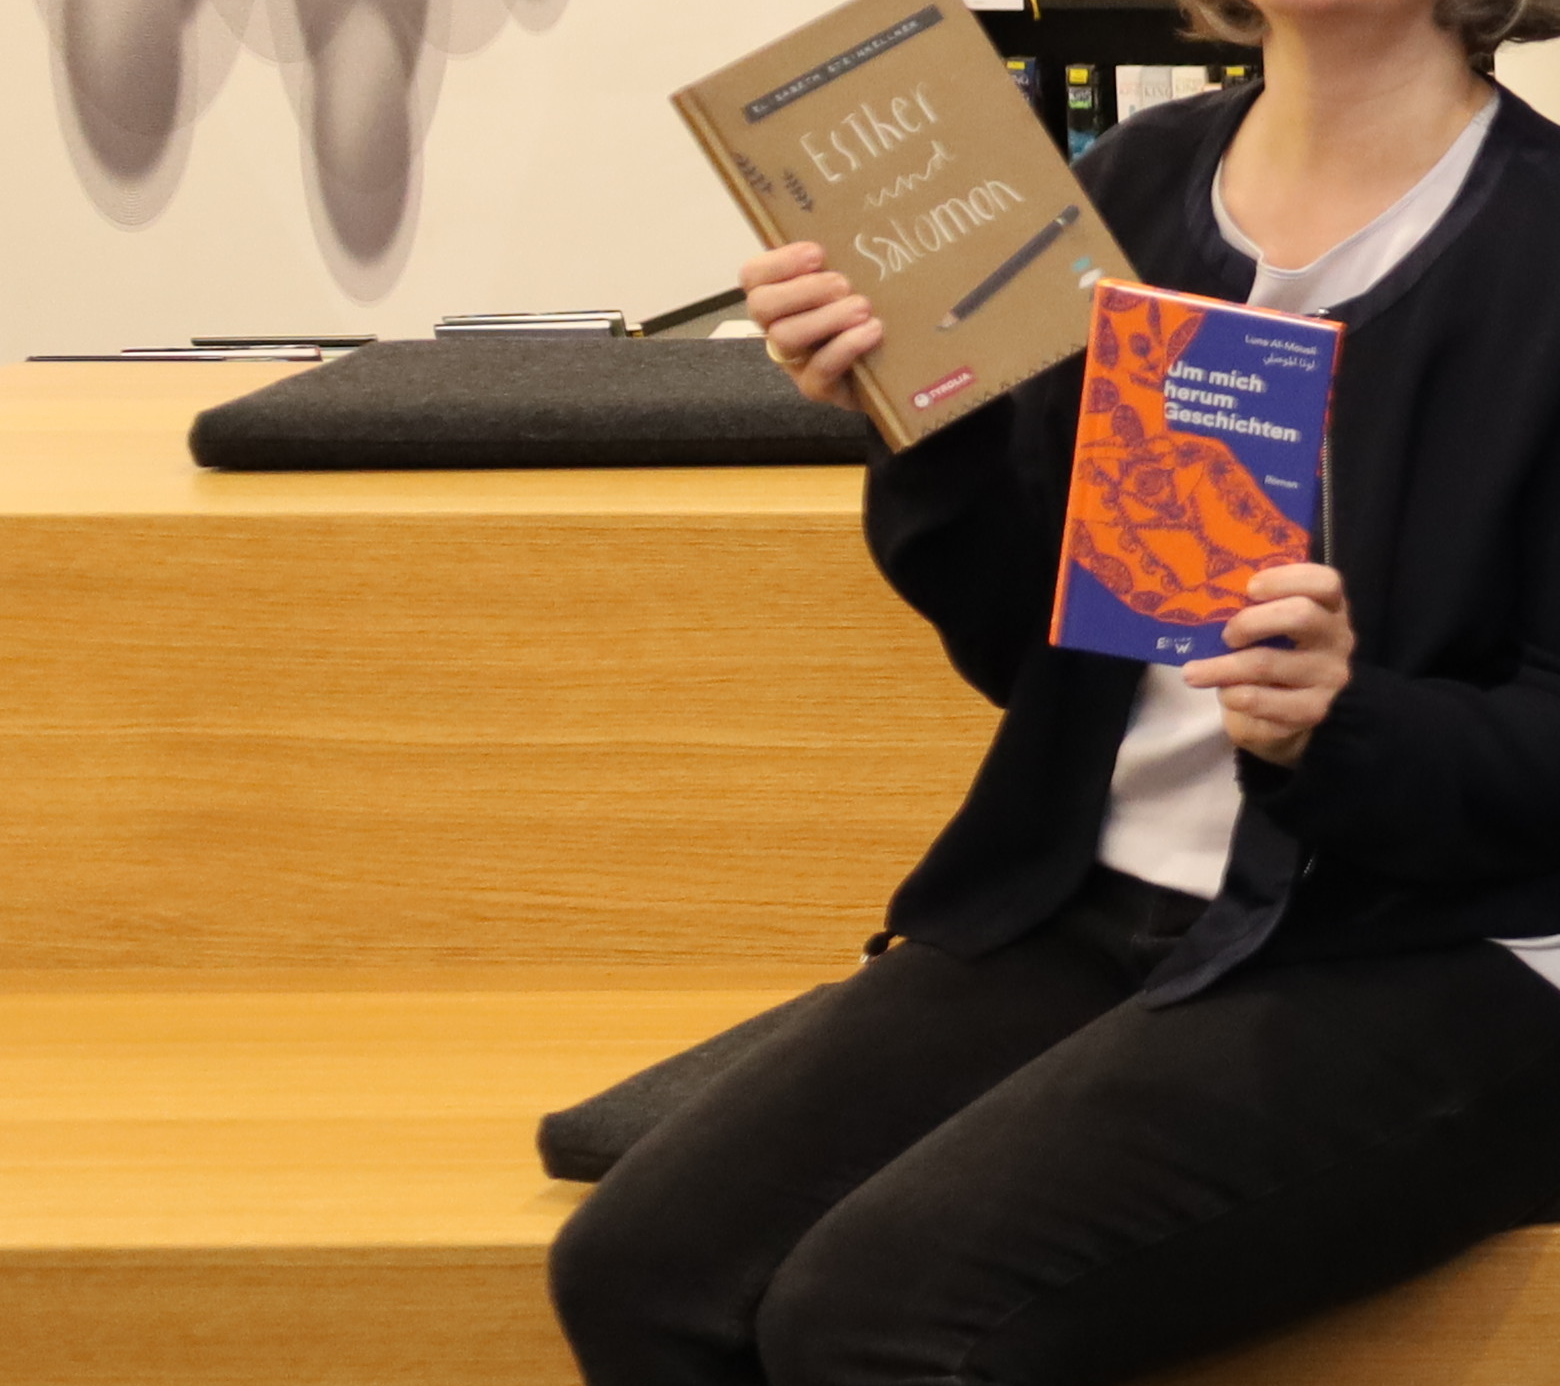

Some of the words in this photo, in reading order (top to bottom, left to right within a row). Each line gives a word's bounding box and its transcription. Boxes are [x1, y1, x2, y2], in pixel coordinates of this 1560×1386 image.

[861, 140, 955, 211] und
[854, 177, 1026, 281] Salomon
[1245, 334, 1269, 347] Luna
[930, 371, 972, 398] TYROLIA
[1166, 360, 1204, 382] Um
[1208, 369, 1266, 393] mich
[1163, 380, 1237, 409] herum
[1164, 402, 1300, 443] Geschichten
